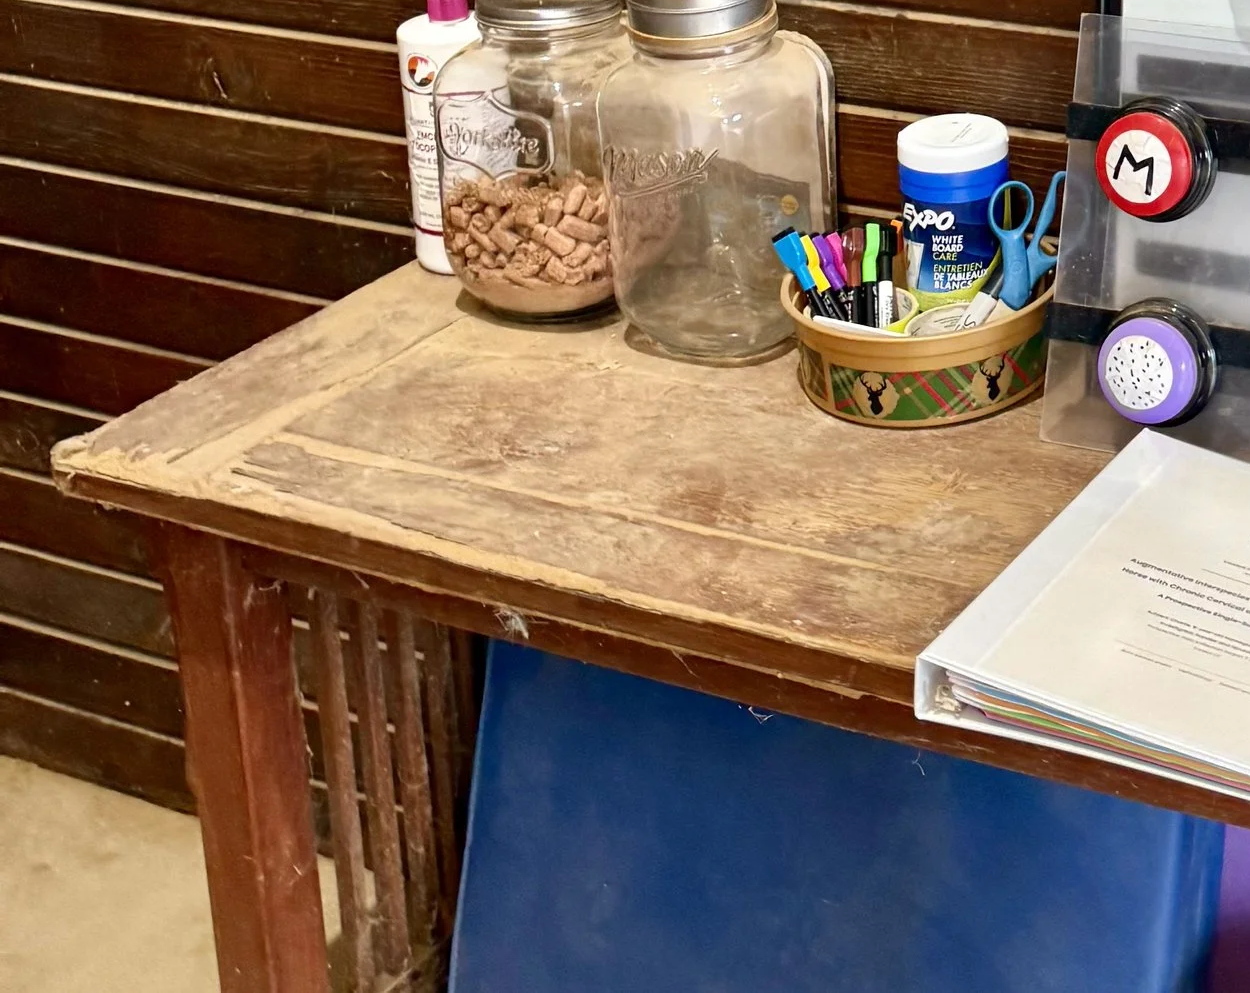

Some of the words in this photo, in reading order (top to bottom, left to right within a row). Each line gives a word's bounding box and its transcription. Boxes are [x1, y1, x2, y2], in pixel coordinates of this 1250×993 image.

[1113, 144, 1154, 196] M
[931, 235, 964, 244] WHITE
[931, 243, 964, 253] BOARD
[932, 252, 958, 261] CARE
[933, 261, 983, 273] ENTRETIEN
[933, 272, 945, 281] DE
[946, 268, 987, 282] TABLEAUX
[934, 280, 973, 290] BLANCS
[1130, 558, 1194, 583] Augmentative
[1195, 579, 1250, 601] Interspecies
[1122, 567, 1148, 579] Horse
[1149, 576, 1168, 587] with
[1170, 583, 1205, 599] Chronic
[1206, 596, 1245, 612] Cervical
[1164, 595, 1212, 615] Prospective
